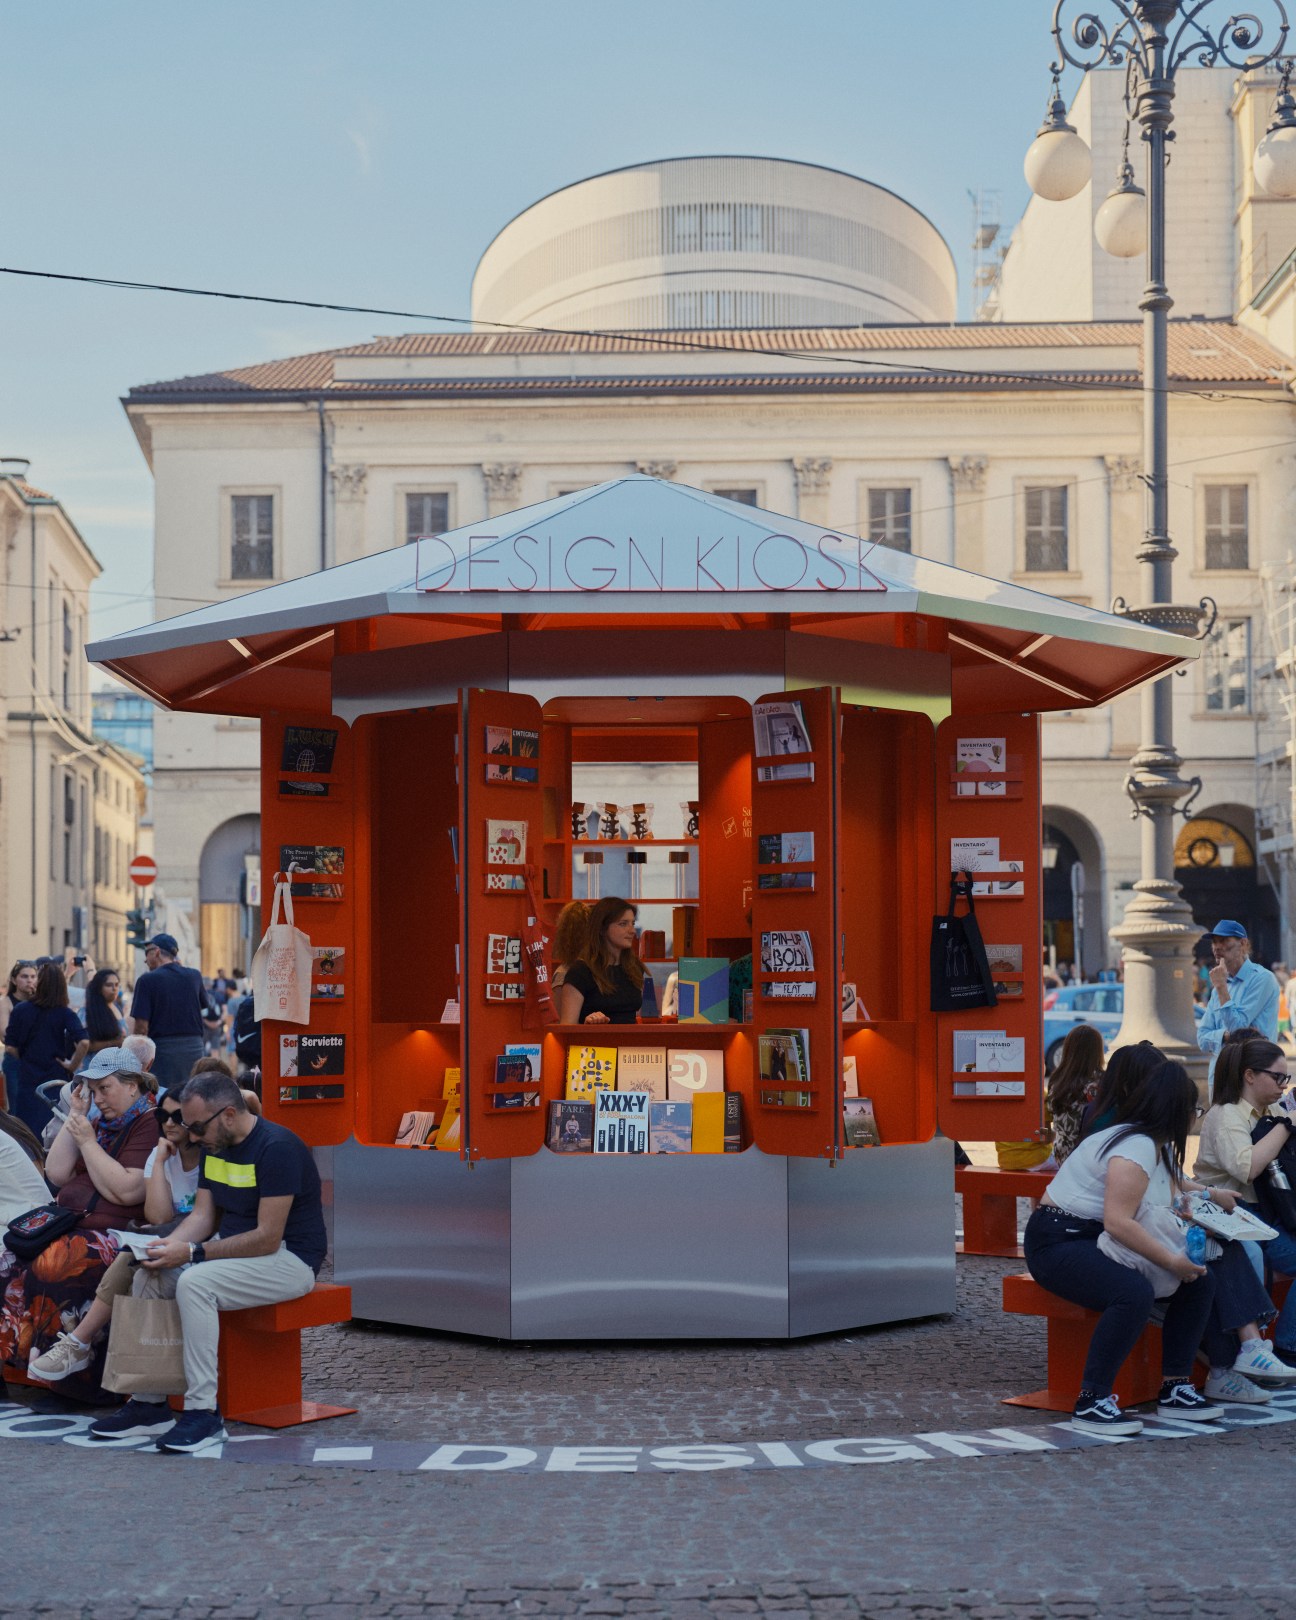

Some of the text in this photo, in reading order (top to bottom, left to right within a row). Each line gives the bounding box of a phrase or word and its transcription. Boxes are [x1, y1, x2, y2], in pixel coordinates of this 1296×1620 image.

[415, 535, 889, 592] DESIGN KIOSK
[771, 932, 802, 946] PIN-UP
[772, 947, 810, 967] BODY
[783, 984, 802, 994] FEAT
[301, 1036, 343, 1047] Serviette
[561, 1105, 585, 1114] FARE
[599, 1094, 647, 1113] XXX-Y
[666, 1104, 676, 1116] F
[416, 1428, 1059, 1472] DESIGN
